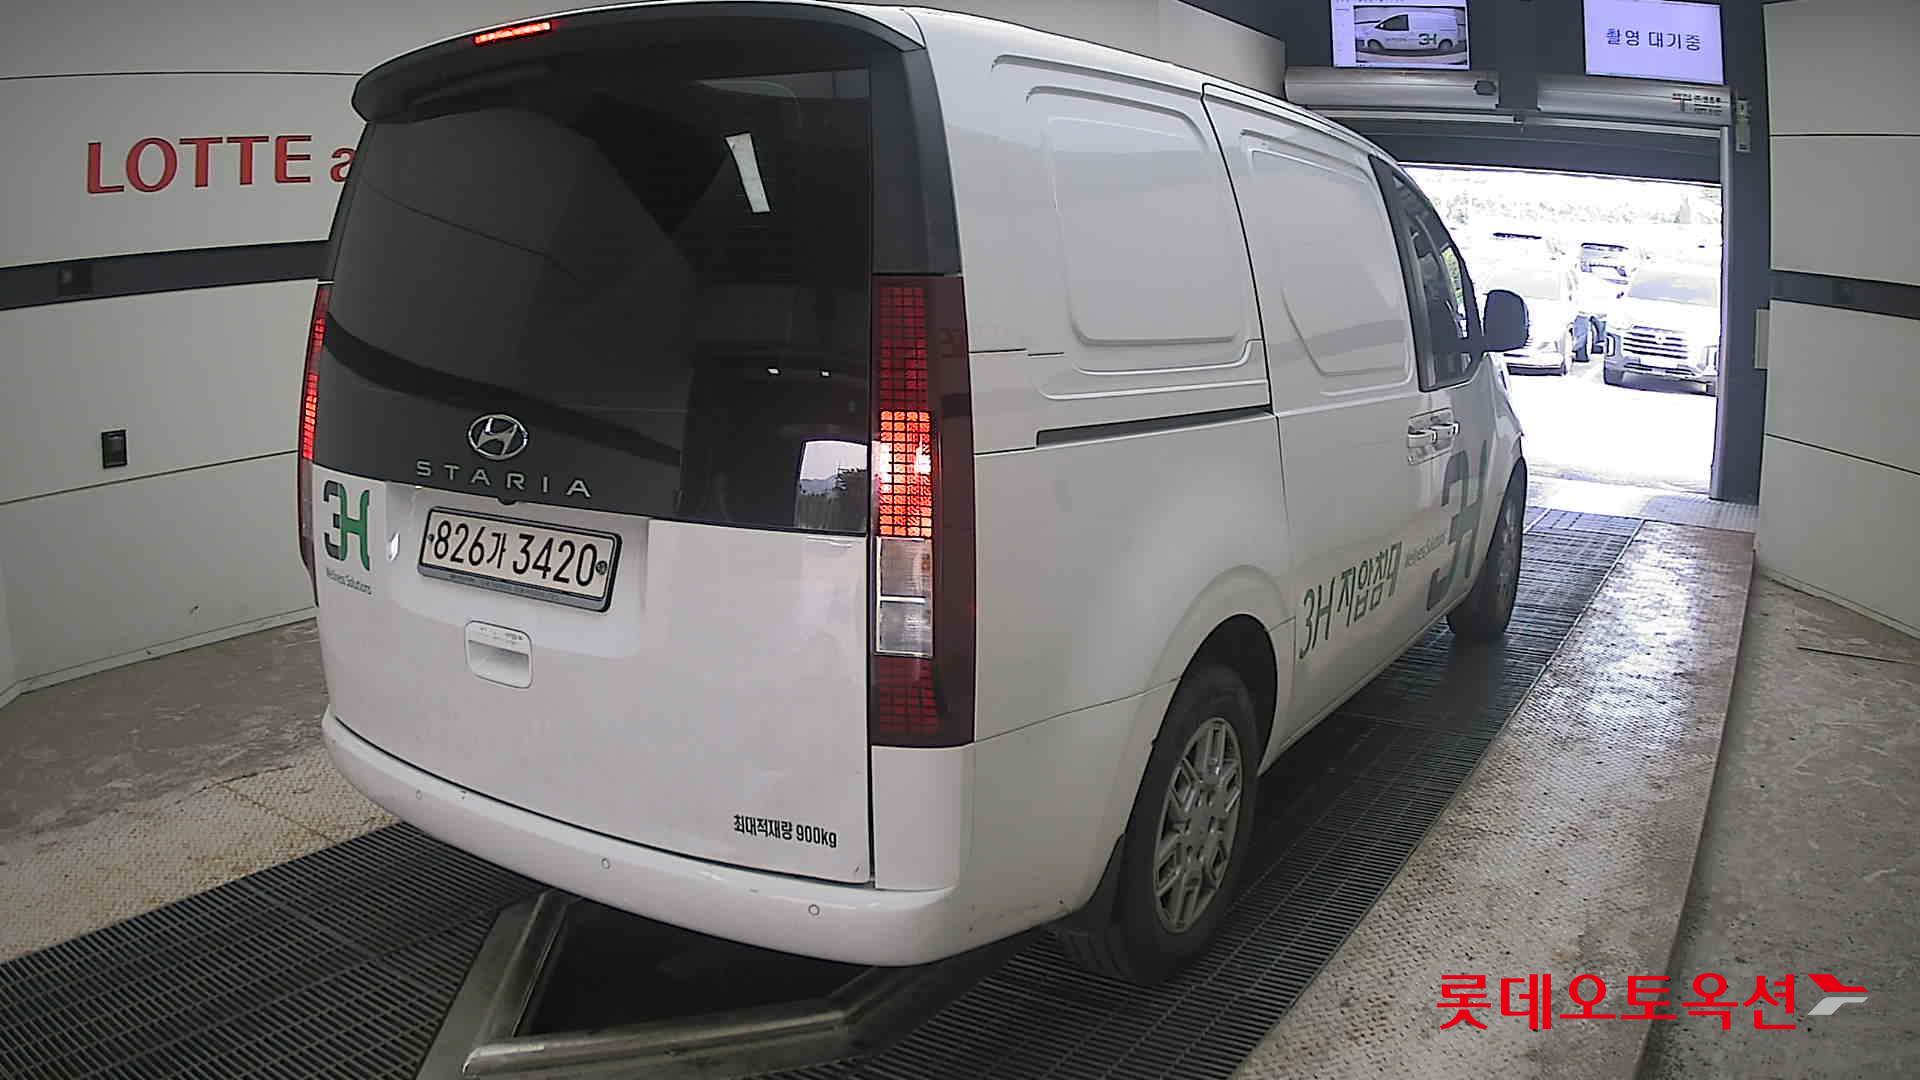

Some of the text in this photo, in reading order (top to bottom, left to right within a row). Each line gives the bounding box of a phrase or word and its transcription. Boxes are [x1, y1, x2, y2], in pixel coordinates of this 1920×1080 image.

[1606, 28, 1701, 51] 촬영 대기중
[86, 134, 313, 194] LOTTE
[416, 460, 592, 498] STARIA
[434, 520, 598, 587] 826가 3420
[1299, 577, 1336, 660] 3H
[733, 814, 837, 849] 최대적재량 900kg
